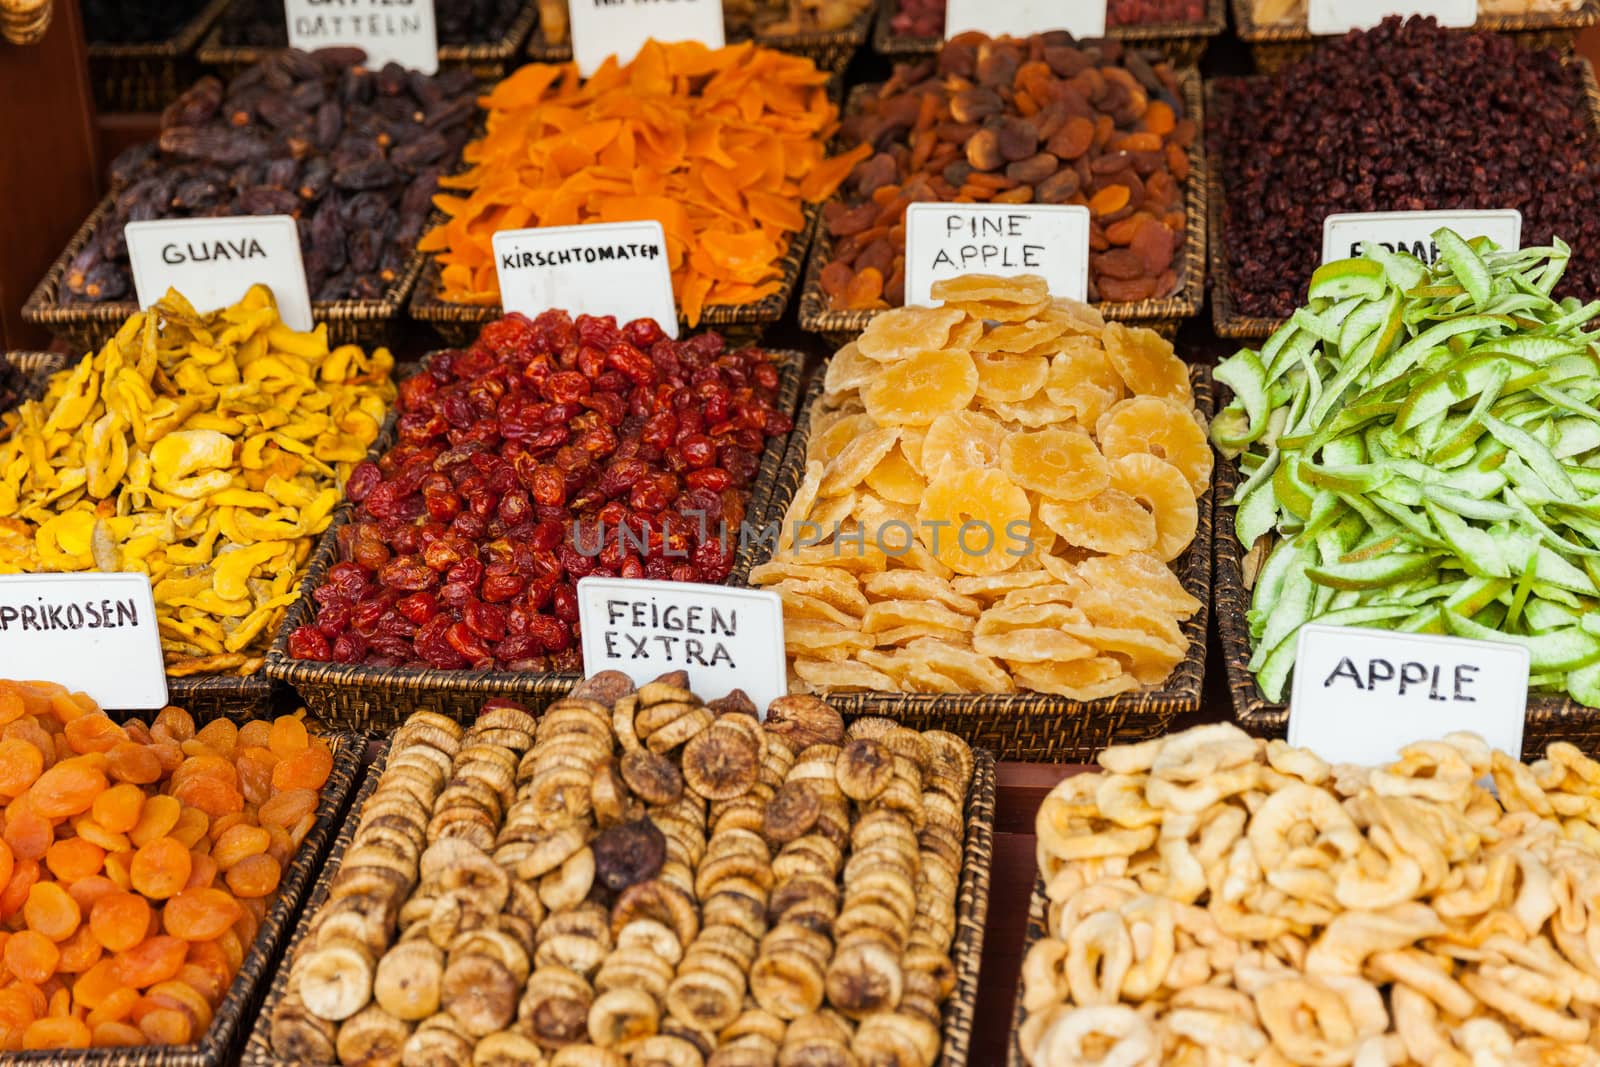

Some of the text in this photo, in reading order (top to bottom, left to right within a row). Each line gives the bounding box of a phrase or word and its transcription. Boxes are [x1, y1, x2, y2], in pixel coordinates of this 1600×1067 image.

[295, 14, 421, 36] DATTELN
[946, 215, 1031, 238] PINE
[162, 238, 266, 264] GUAVA
[502, 244, 660, 269] KIRSCHTOMATEN
[932, 244, 1046, 270] APPLE
[0, 596, 138, 631] PRIKOSEN
[607, 597, 736, 636] FEIGEN
[605, 631, 736, 668] EXTRA
[1324, 656, 1480, 702] APPLE
